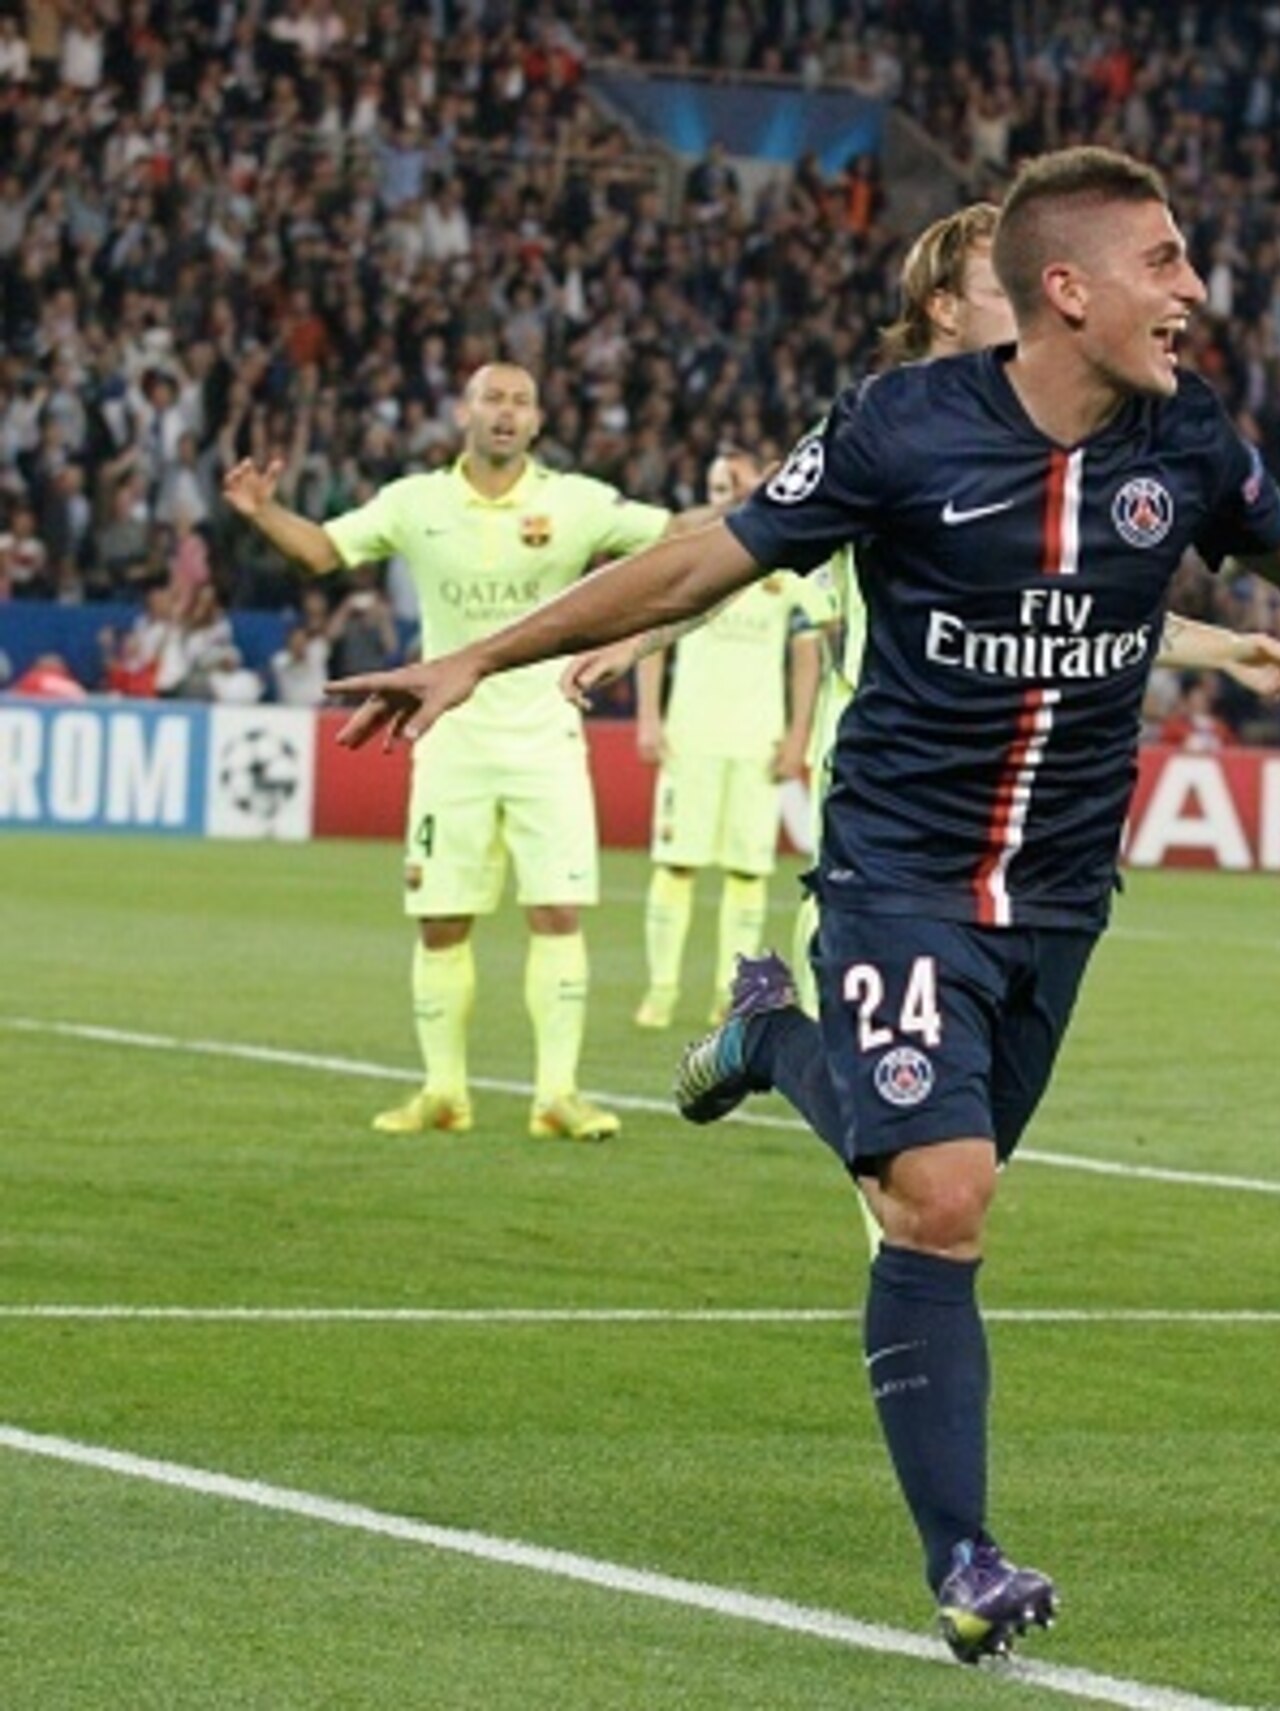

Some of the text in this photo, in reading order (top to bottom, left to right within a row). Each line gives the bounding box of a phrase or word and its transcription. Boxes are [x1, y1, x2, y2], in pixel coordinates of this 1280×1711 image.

[438, 580, 542, 606] QATAR
[1019, 588, 1094, 633] Fly
[925, 609, 1152, 679] Emirates
[0, 708, 190, 826] ROM
[414, 812, 435, 859] 4
[843, 955, 942, 1052] 24
